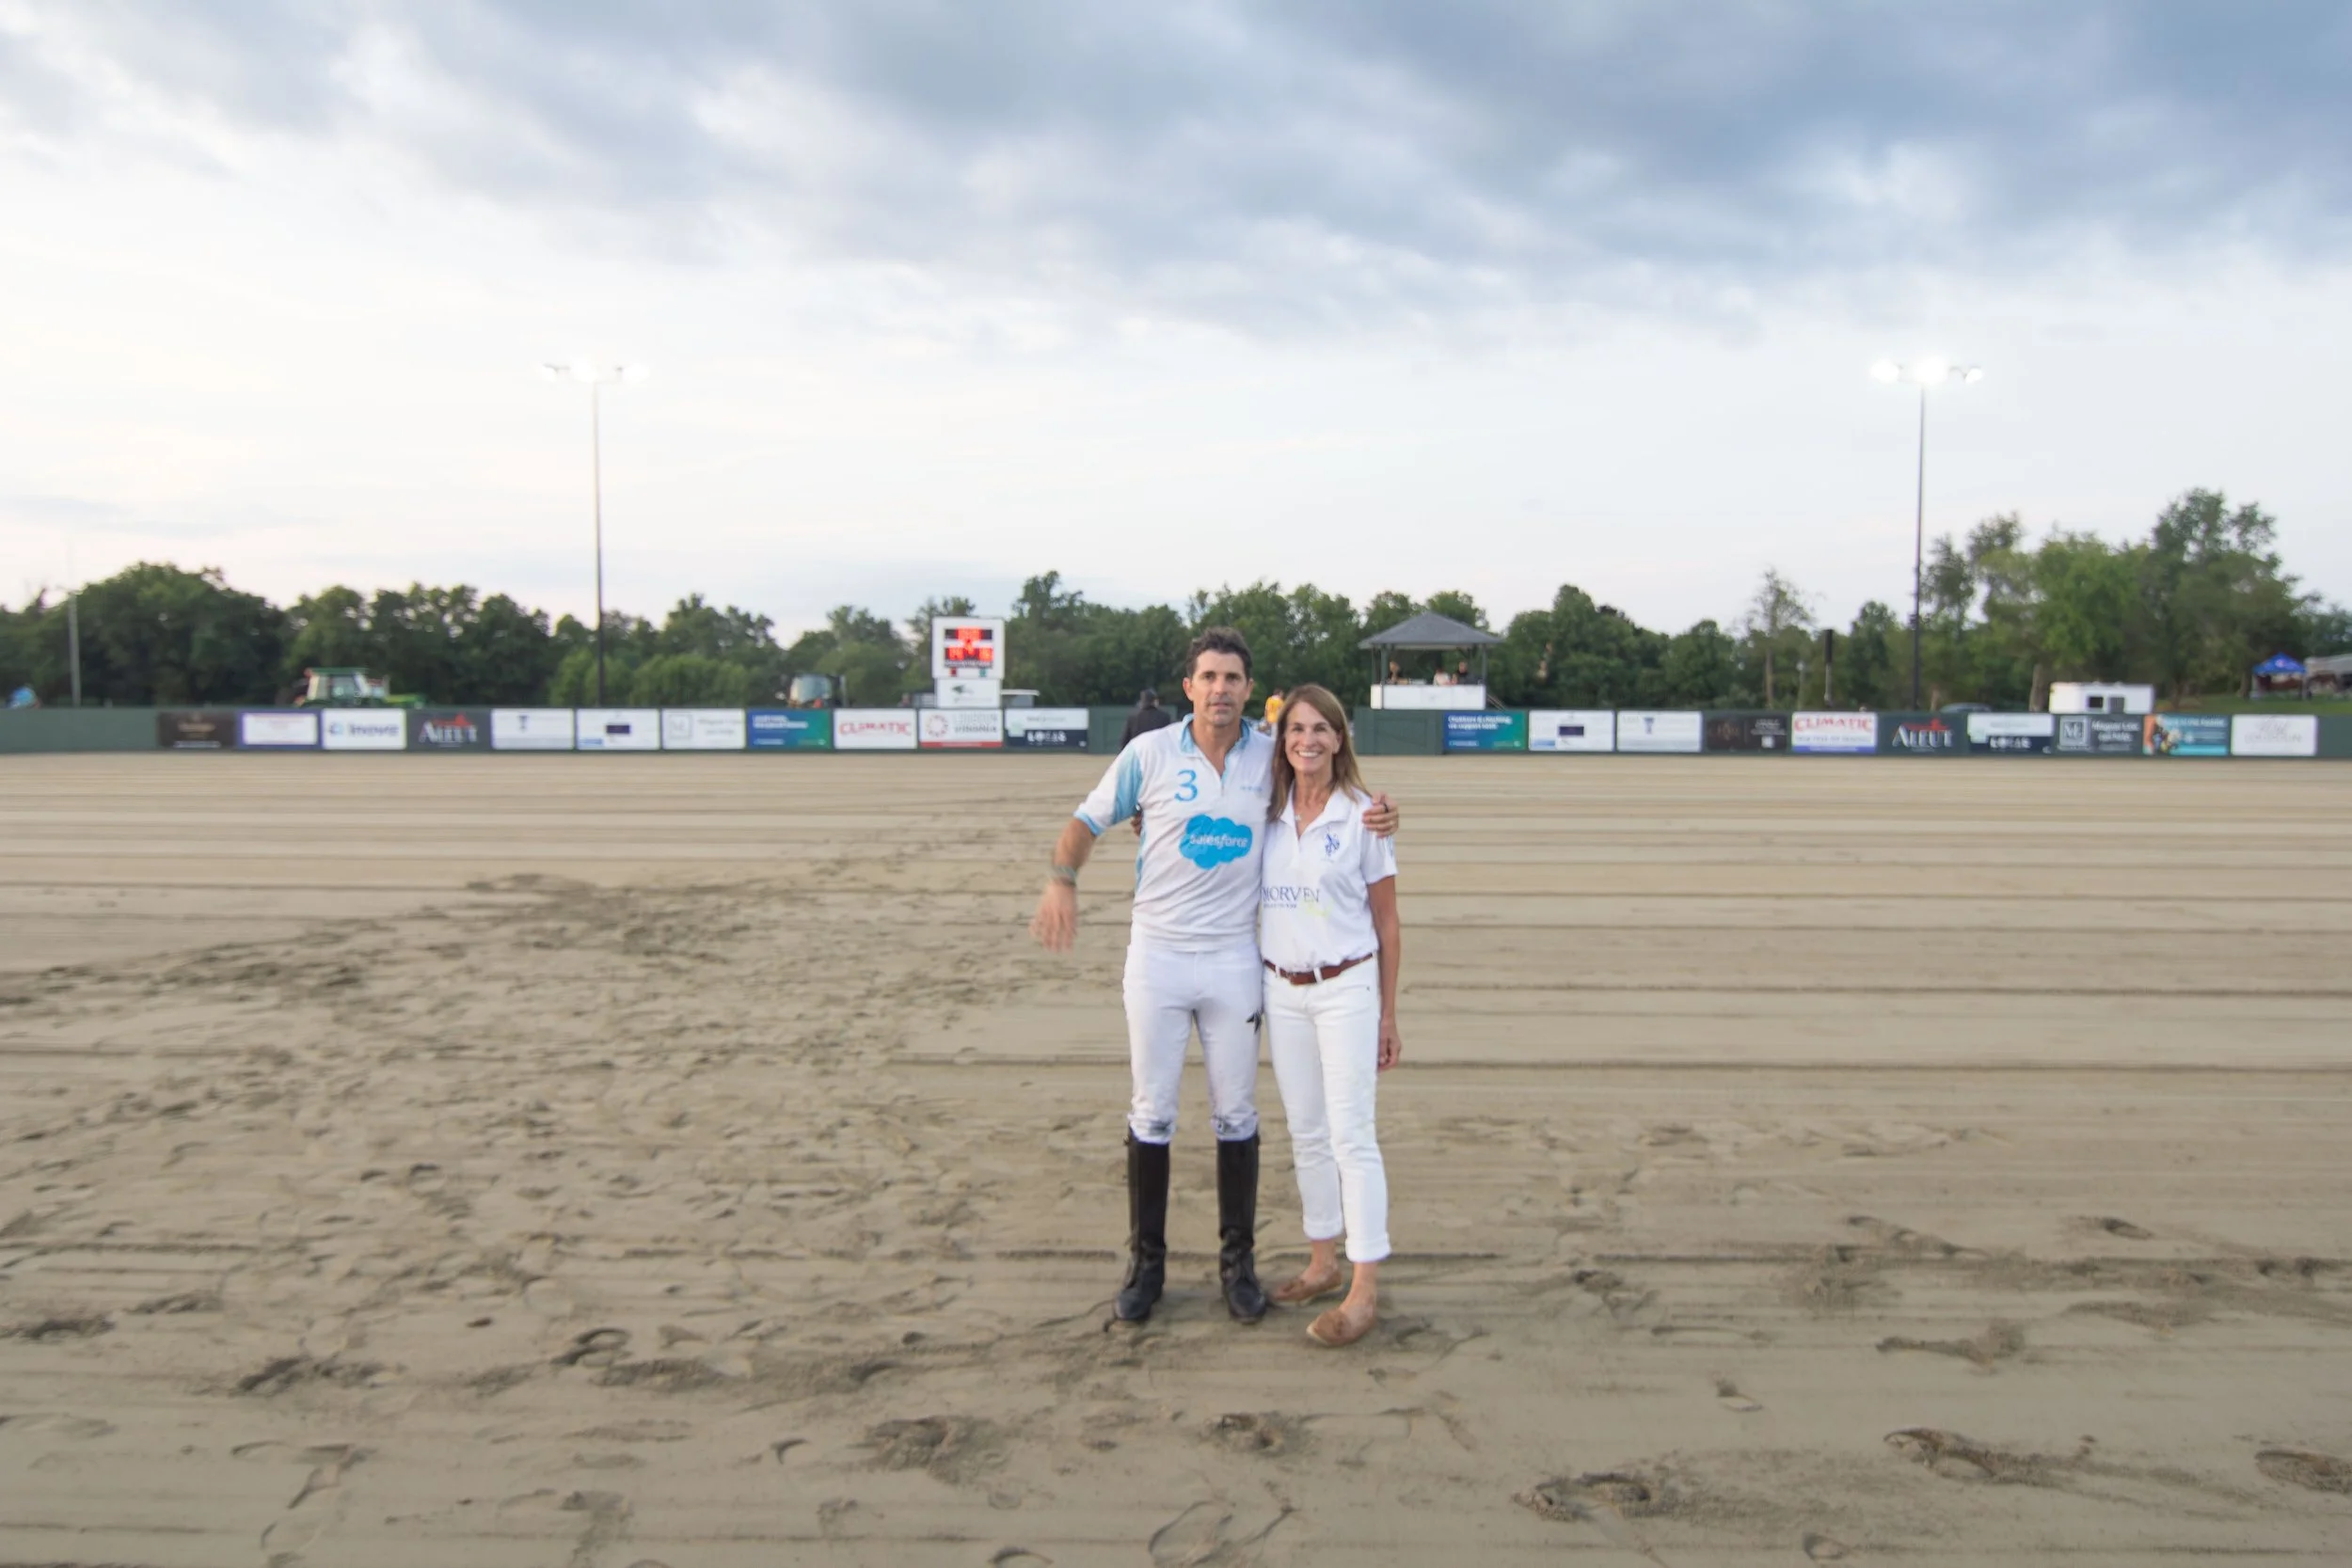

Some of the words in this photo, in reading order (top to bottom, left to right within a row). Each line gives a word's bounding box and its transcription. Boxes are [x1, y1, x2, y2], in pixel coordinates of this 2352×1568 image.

[838, 721, 912, 736] CLIMATIC
[1793, 716, 1872, 733] CLIMATIC
[1174, 769, 1198, 801] 3
[1260, 886, 1320, 903] MORVEN
